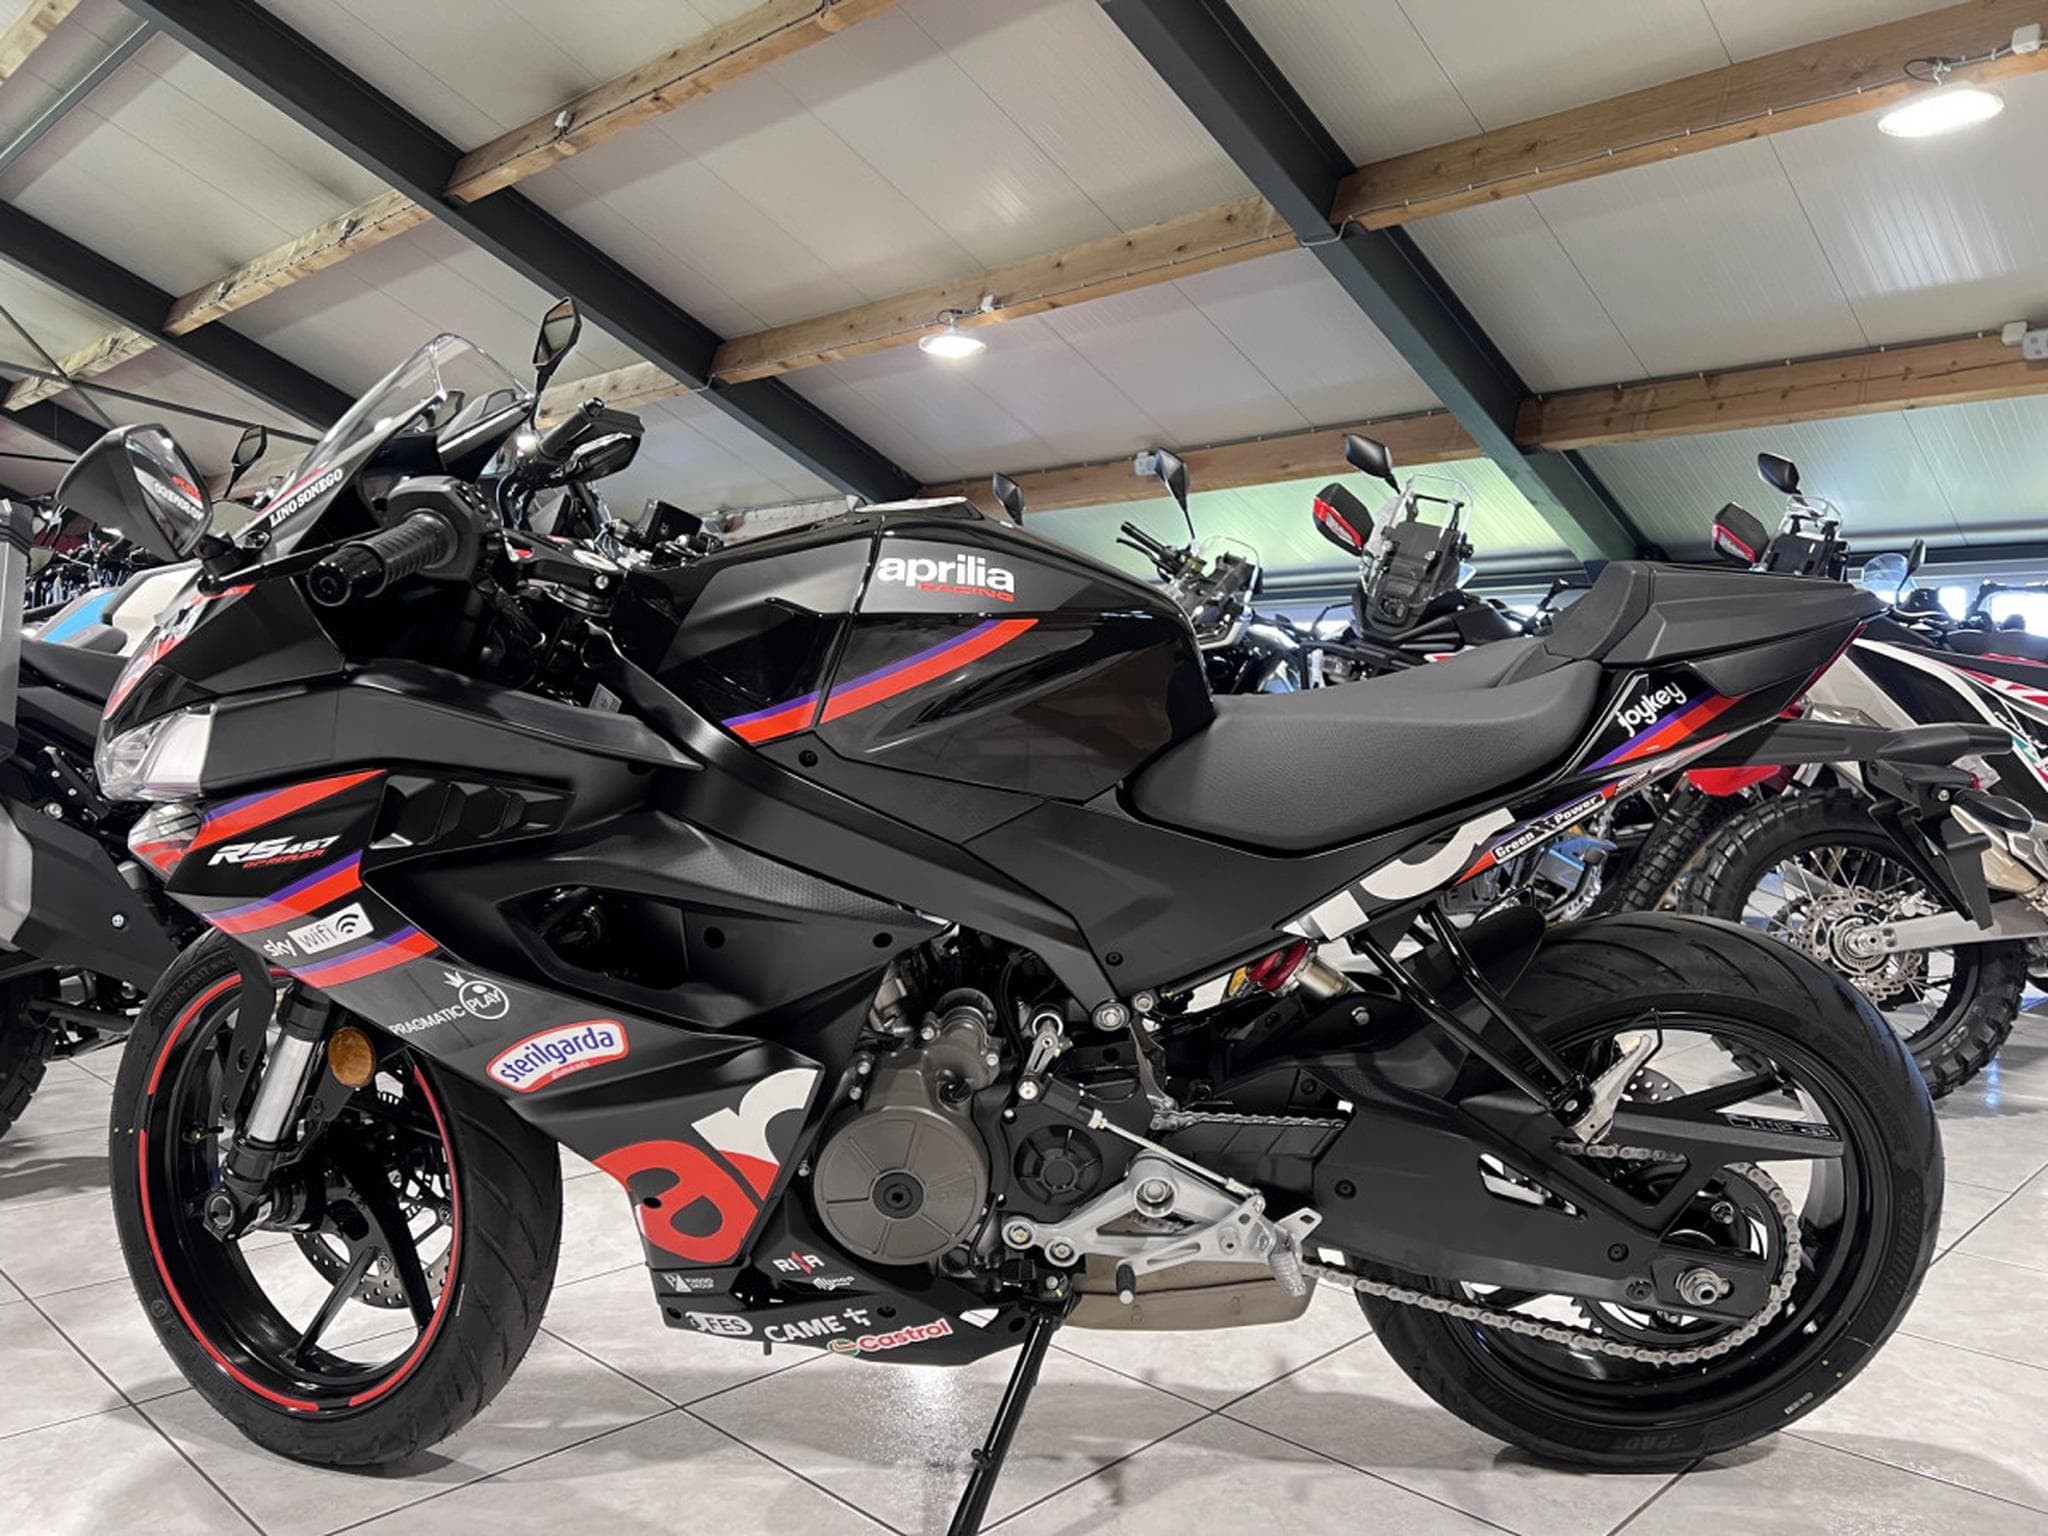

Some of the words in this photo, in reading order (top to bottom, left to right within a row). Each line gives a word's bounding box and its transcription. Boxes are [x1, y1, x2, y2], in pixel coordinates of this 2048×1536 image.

[269, 501, 297, 528] LINO
[296, 468, 343, 508] SONEGO
[877, 553, 1015, 593] aprilia
[917, 582, 1016, 603] RACING
[1615, 681, 1687, 738] joykey
[1494, 831, 1536, 859] Green
[1553, 796, 1598, 826] Power
[263, 938, 298, 957] sky
[388, 1003, 467, 1036] PRAGMATIC
[466, 988, 504, 1013] PLAY
[500, 1026, 615, 1084] sterilgarda
[763, 1315, 847, 1343] CAME
[858, 1318, 952, 1351] Castrol
